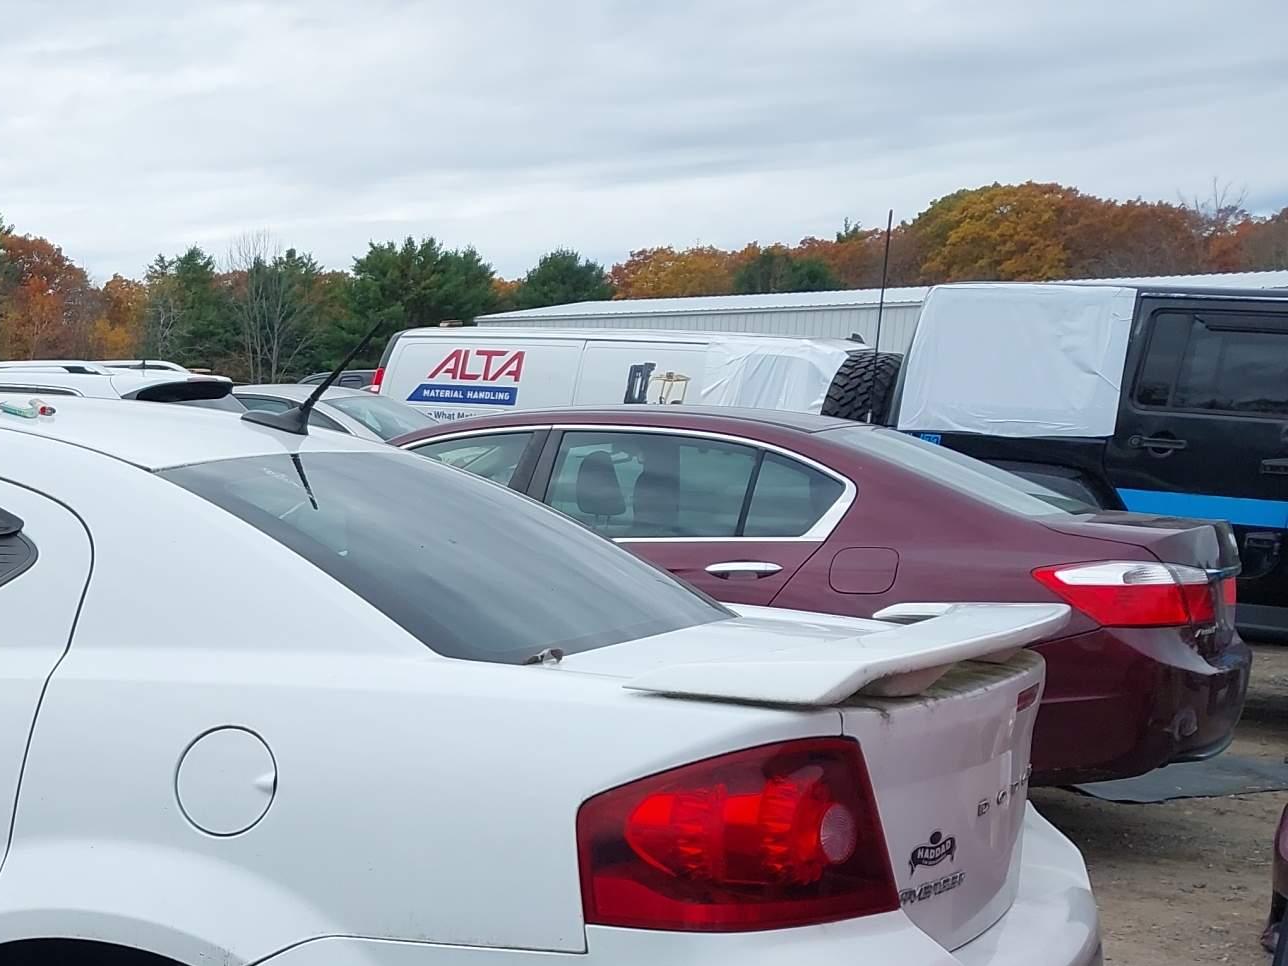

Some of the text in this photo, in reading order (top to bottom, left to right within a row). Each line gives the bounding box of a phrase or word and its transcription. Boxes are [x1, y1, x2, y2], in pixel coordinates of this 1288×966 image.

[427, 349, 526, 382] ALTA
[423, 388, 510, 400] MATERIAL HANDLING
[433, 410, 455, 421] What
[917, 840, 952, 859] HADDAD
